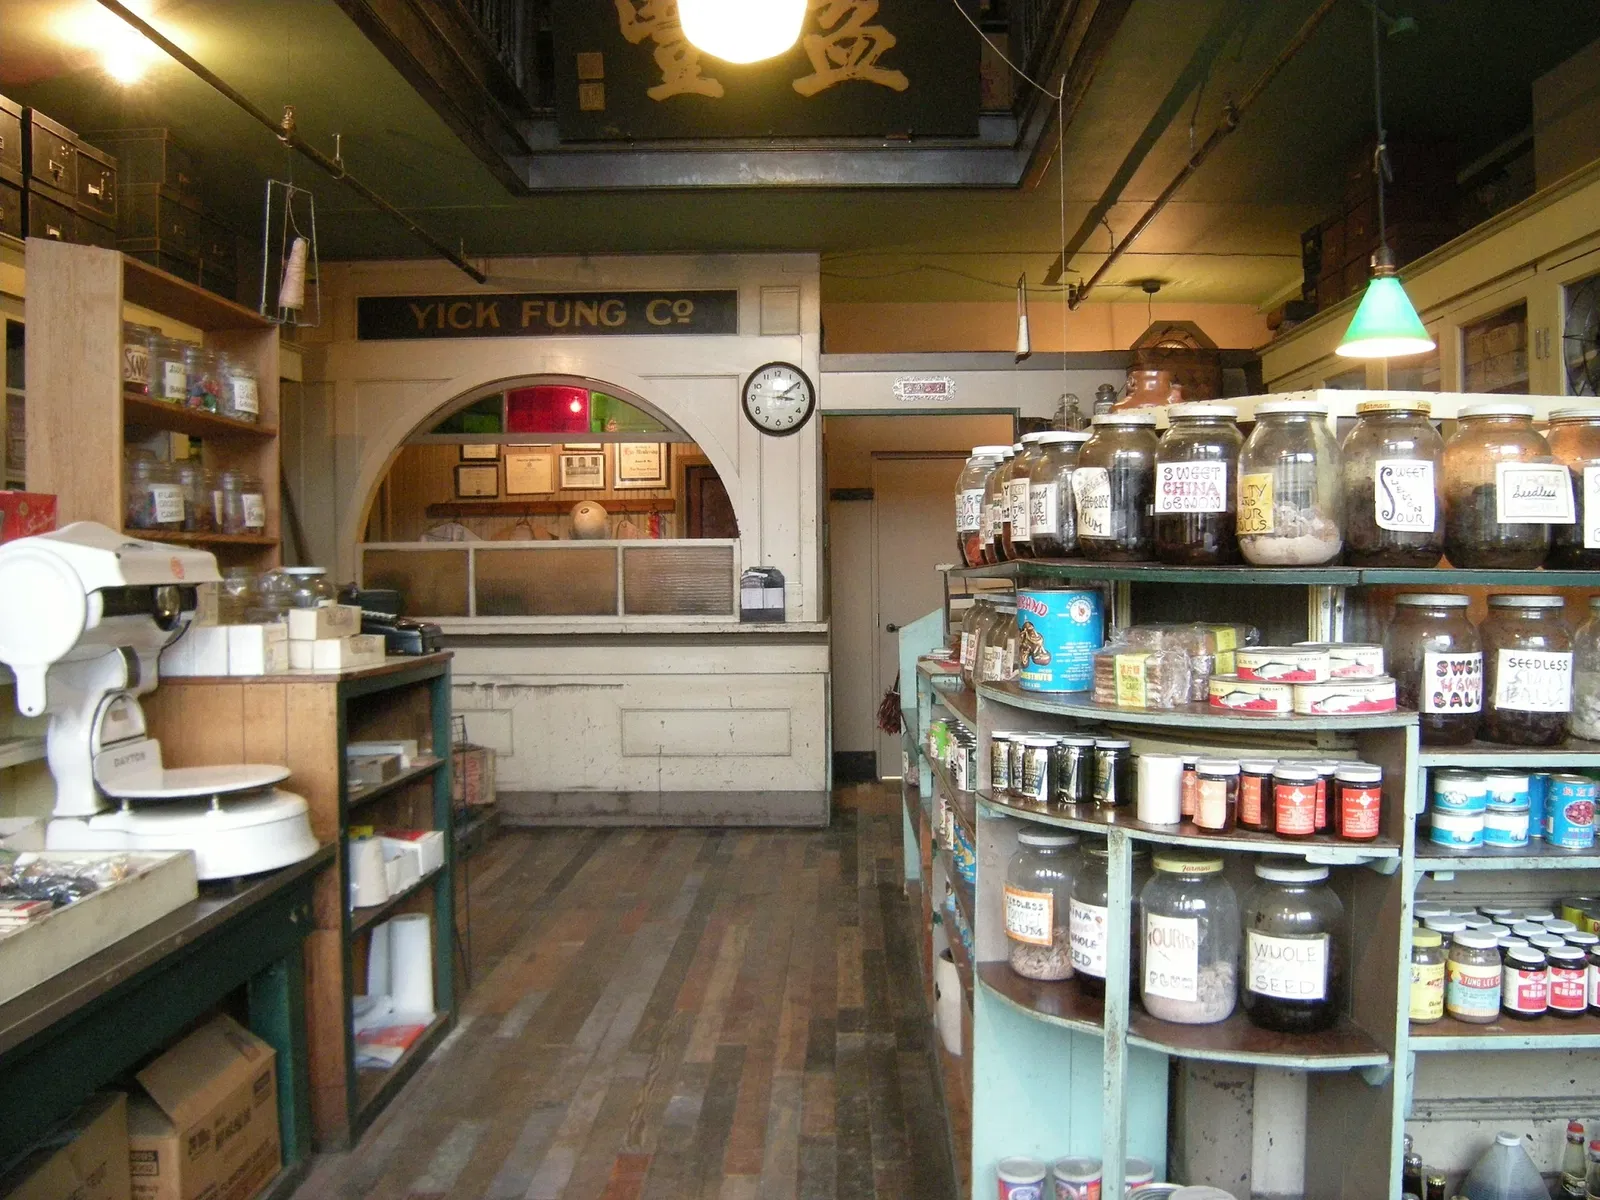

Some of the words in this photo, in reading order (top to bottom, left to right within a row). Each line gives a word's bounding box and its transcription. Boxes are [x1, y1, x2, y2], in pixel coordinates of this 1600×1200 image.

[409, 301, 500, 329] YICK
[521, 299, 627, 328] FUNG
[750, 394, 756, 402] 9
[800, 394, 805, 402] 3
[754, 406, 761, 415] 8
[764, 415, 769, 423] 7
[775, 418, 781, 426] 6
[787, 415, 793, 423] 5
[1164, 466, 1221, 481] SWEET
[1163, 481, 1221, 497] CHINA
[1242, 483, 1267, 499] LTY
[1162, 496, 1221, 510] LEMON
[1017, 594, 1048, 616] RAND
[1508, 657, 1568, 671] SEEDLESS
[1070, 946, 1092, 967] EED
[1255, 975, 1314, 994] SEED
[1464, 976, 1481, 987] TUNG
